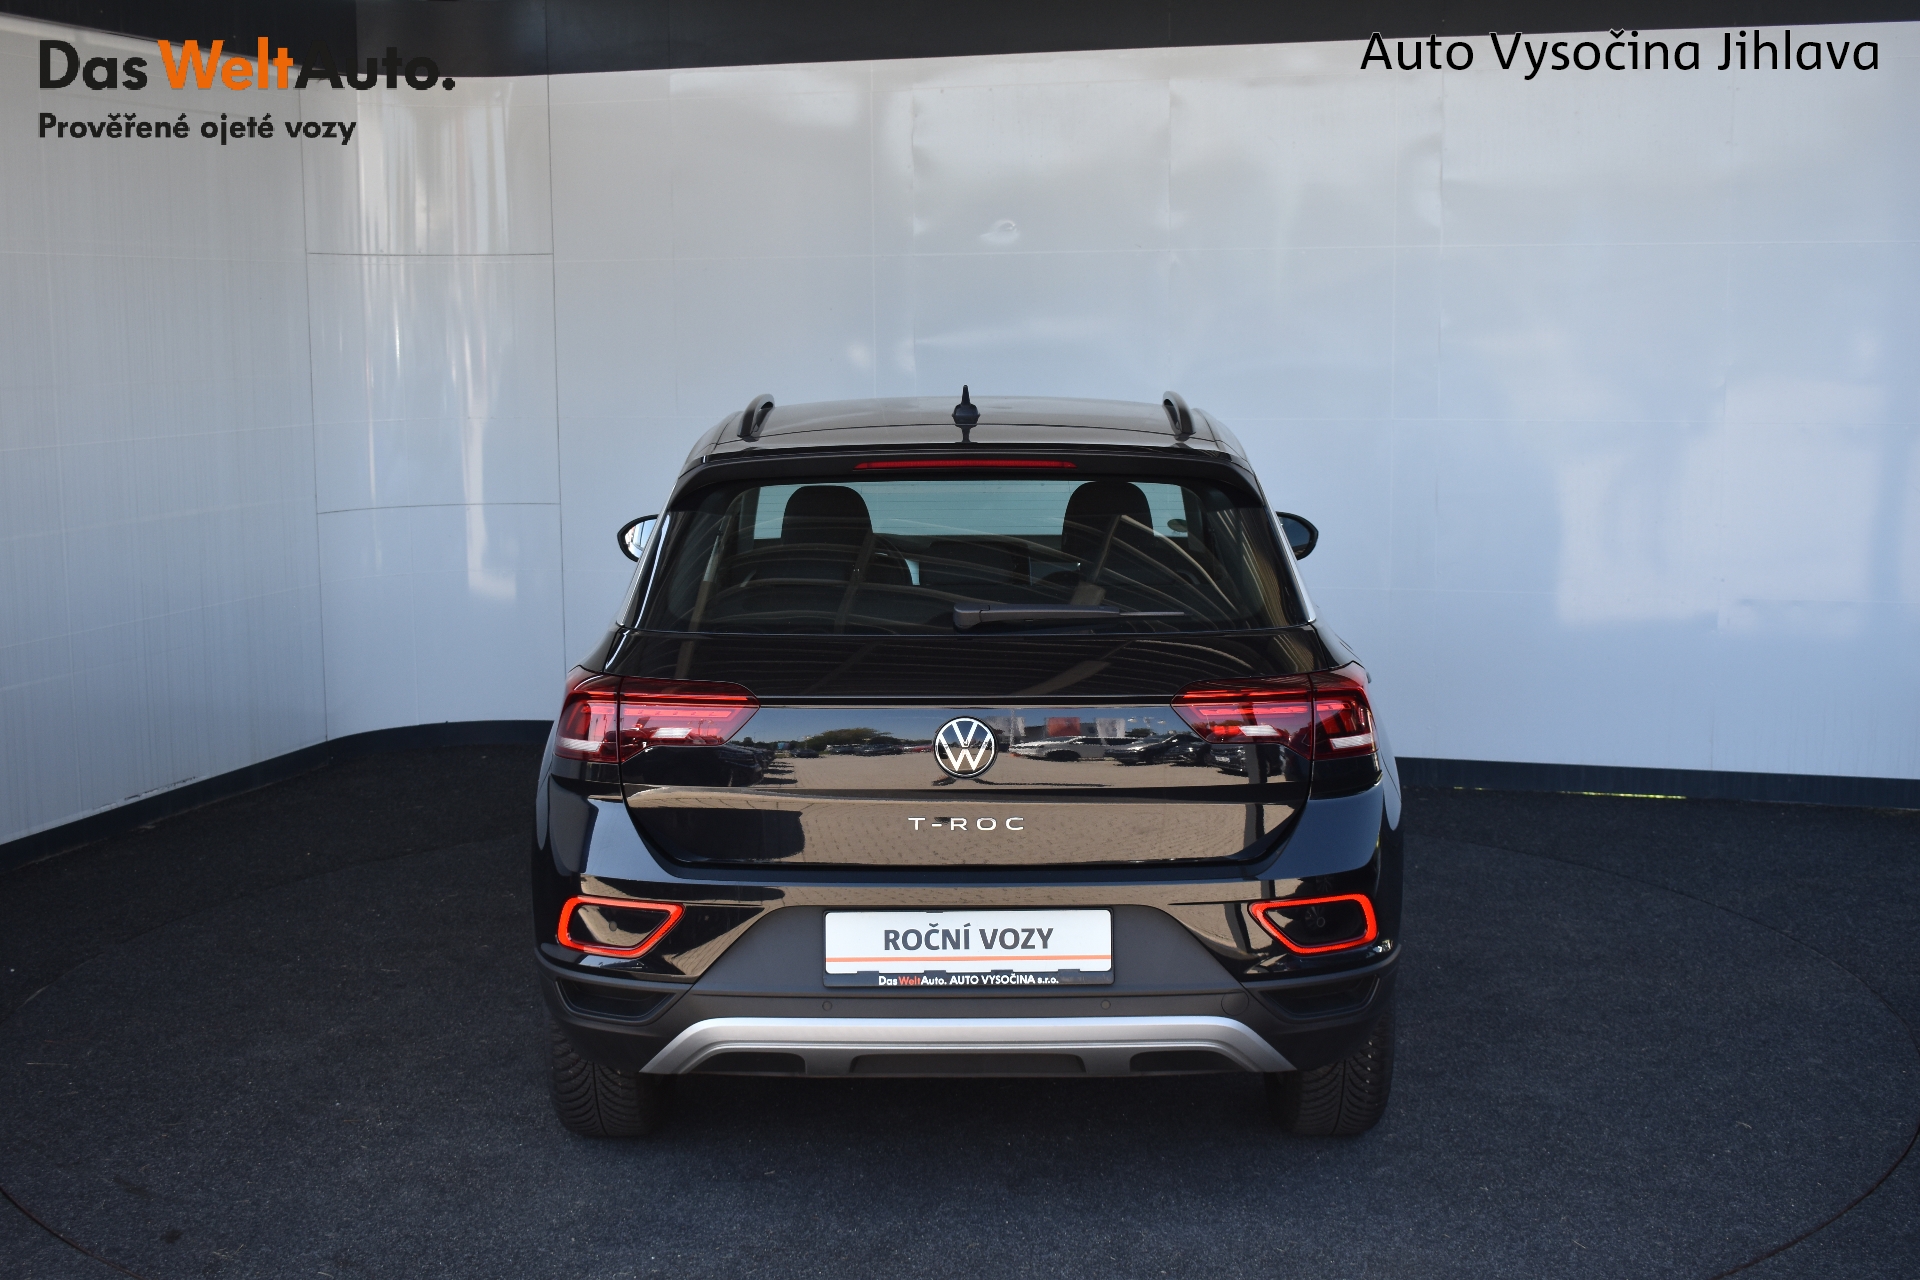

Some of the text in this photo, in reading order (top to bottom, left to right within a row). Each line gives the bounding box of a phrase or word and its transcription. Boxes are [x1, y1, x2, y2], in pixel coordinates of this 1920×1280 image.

[907, 816, 1025, 831] T-ROC
[883, 922, 1054, 951] ROČNÍ VOZY
[878, 975, 898, 986] Das
[949, 974, 979, 985] AUTO
[981, 972, 1036, 985] VYSOČINA
[1037, 976, 1059, 985] s.r.o.
